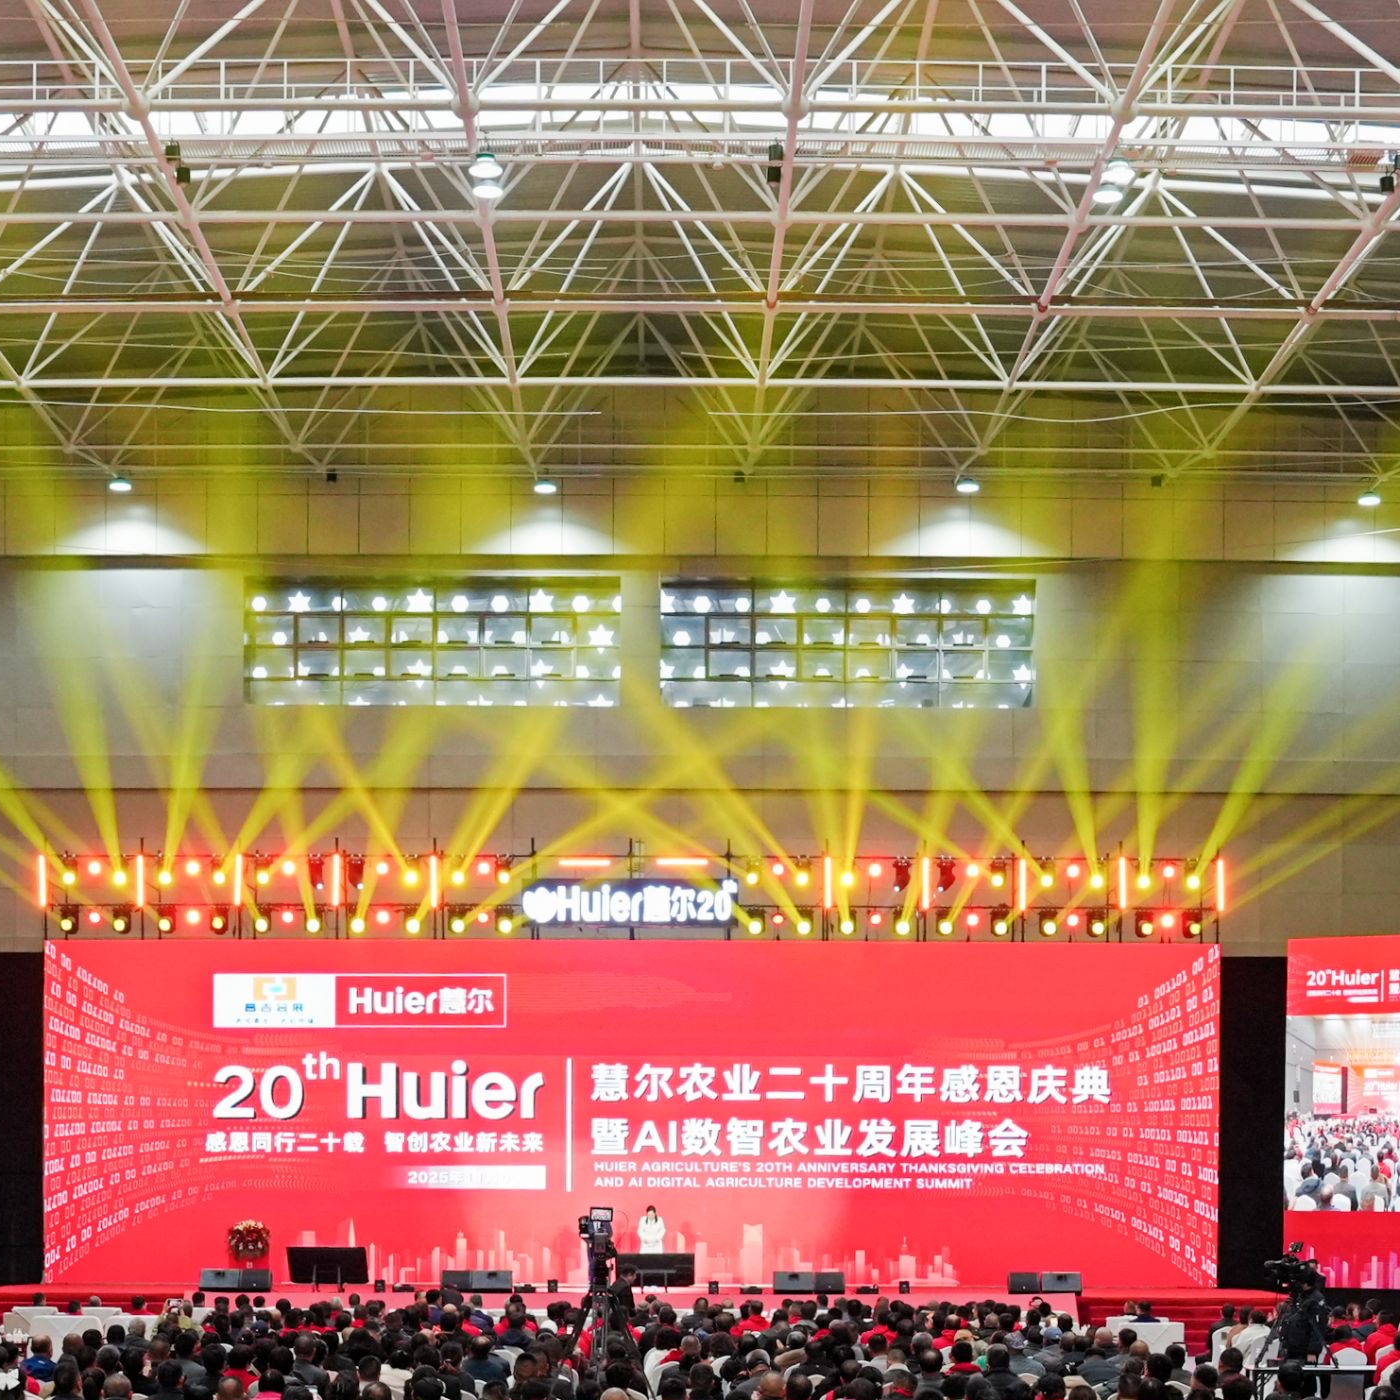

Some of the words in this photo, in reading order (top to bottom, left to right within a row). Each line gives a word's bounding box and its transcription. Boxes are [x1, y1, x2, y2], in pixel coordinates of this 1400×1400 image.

[1331, 969, 1379, 986] Huier
[349, 987, 494, 1015] Huier慧尔
[213, 1052, 341, 1120] 20th
[347, 1060, 544, 1120] Huier
[591, 1063, 1111, 1104] 慧尔农业二十周年感恩庆典
[206, 1132, 365, 1153] 感恩同行二十载
[384, 1132, 544, 1153] 智创农业新未来
[591, 1117, 1029, 1157] 暨AI数智农业发展峰会
[594, 1162, 637, 1173] HUIER
[641, 1162, 751, 1173] AGRICULTURE'S
[796, 1163, 895, 1174] ANNIVERSARY
[901, 1163, 1004, 1174] THANKSGIVING
[1009, 1163, 1105, 1175] CELEBRATION
[594, 1177, 624, 1188] AND
[628, 1177, 643, 1188] AI
[647, 1177, 700, 1188] DIGITAL
[705, 1177, 802, 1188] AGRICULTURE
[807, 1178, 911, 1189] DEVELOPMENT
[916, 1178, 973, 1189] SUMMIT
